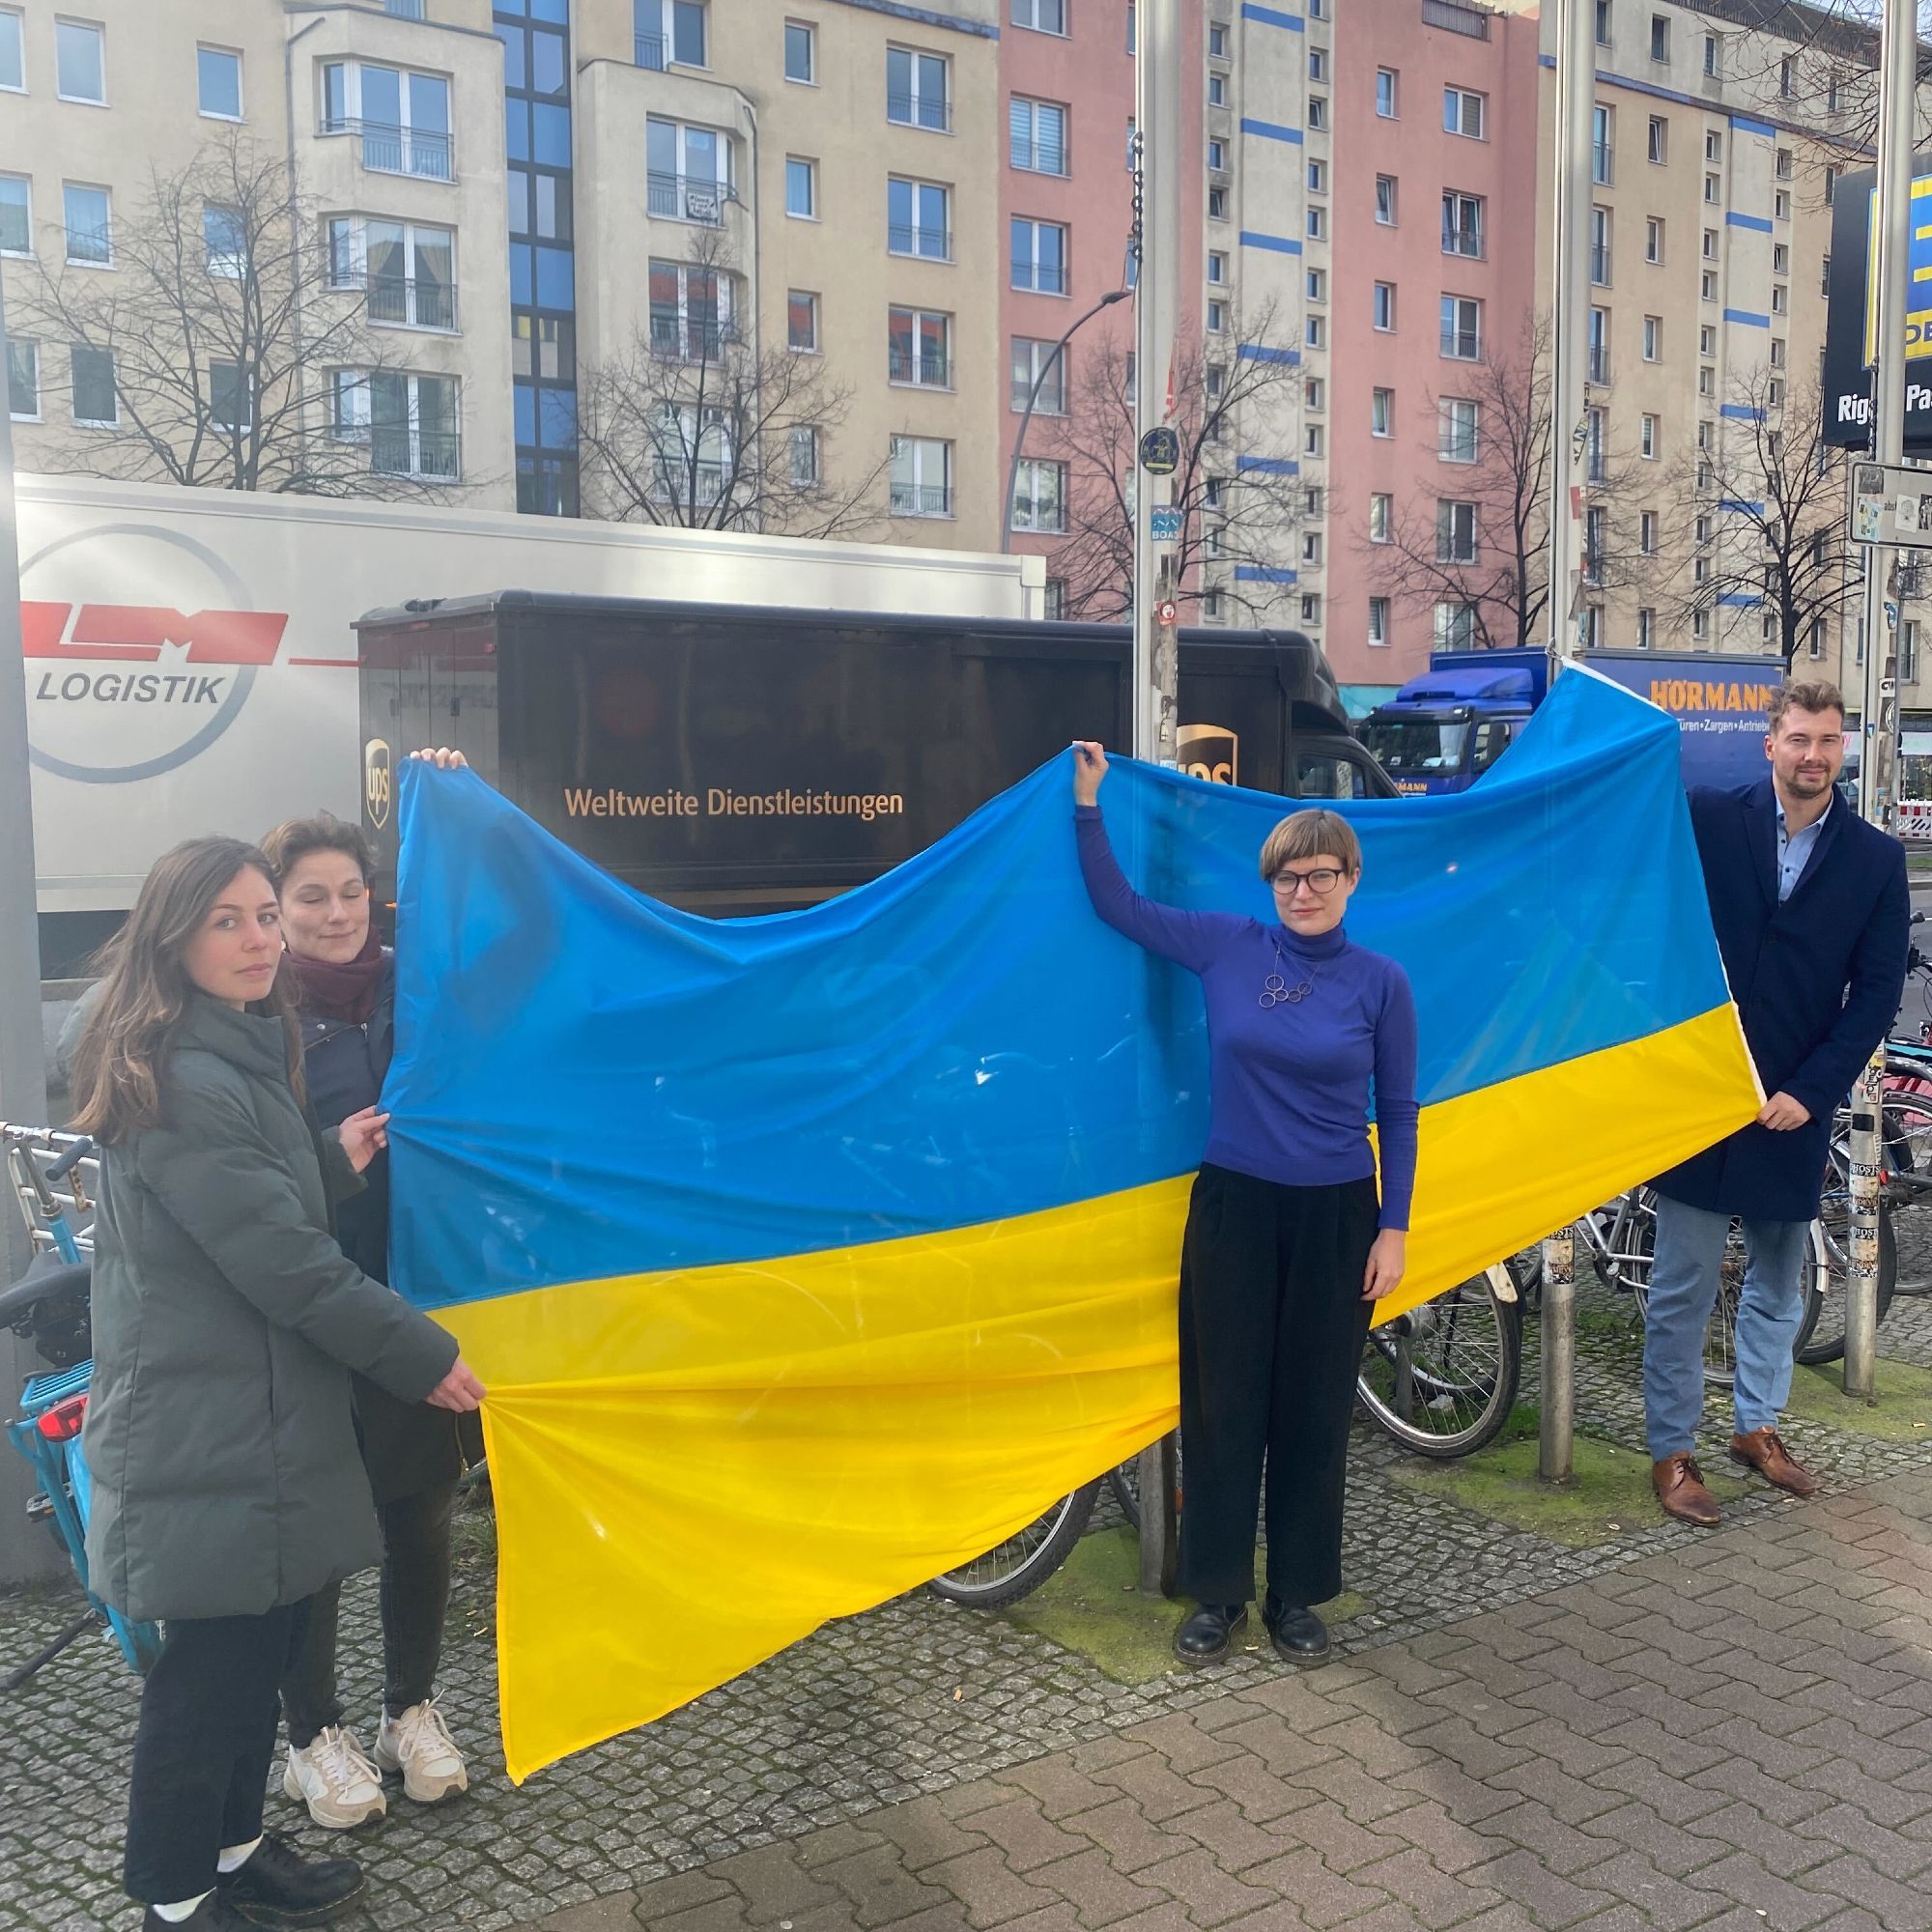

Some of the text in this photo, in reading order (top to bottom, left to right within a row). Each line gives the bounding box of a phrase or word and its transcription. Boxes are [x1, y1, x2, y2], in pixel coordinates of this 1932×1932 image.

[1906, 384, 1932, 412] Pa
[36, 671, 226, 704] LOGISTIK
[1678, 719, 1700, 731] üren
[1704, 719, 1734, 734] Zargen
[368, 766, 388, 815] ups
[1394, 781, 1428, 791] MANN
[564, 787, 903, 821] Weltweite Dienstleistungen
